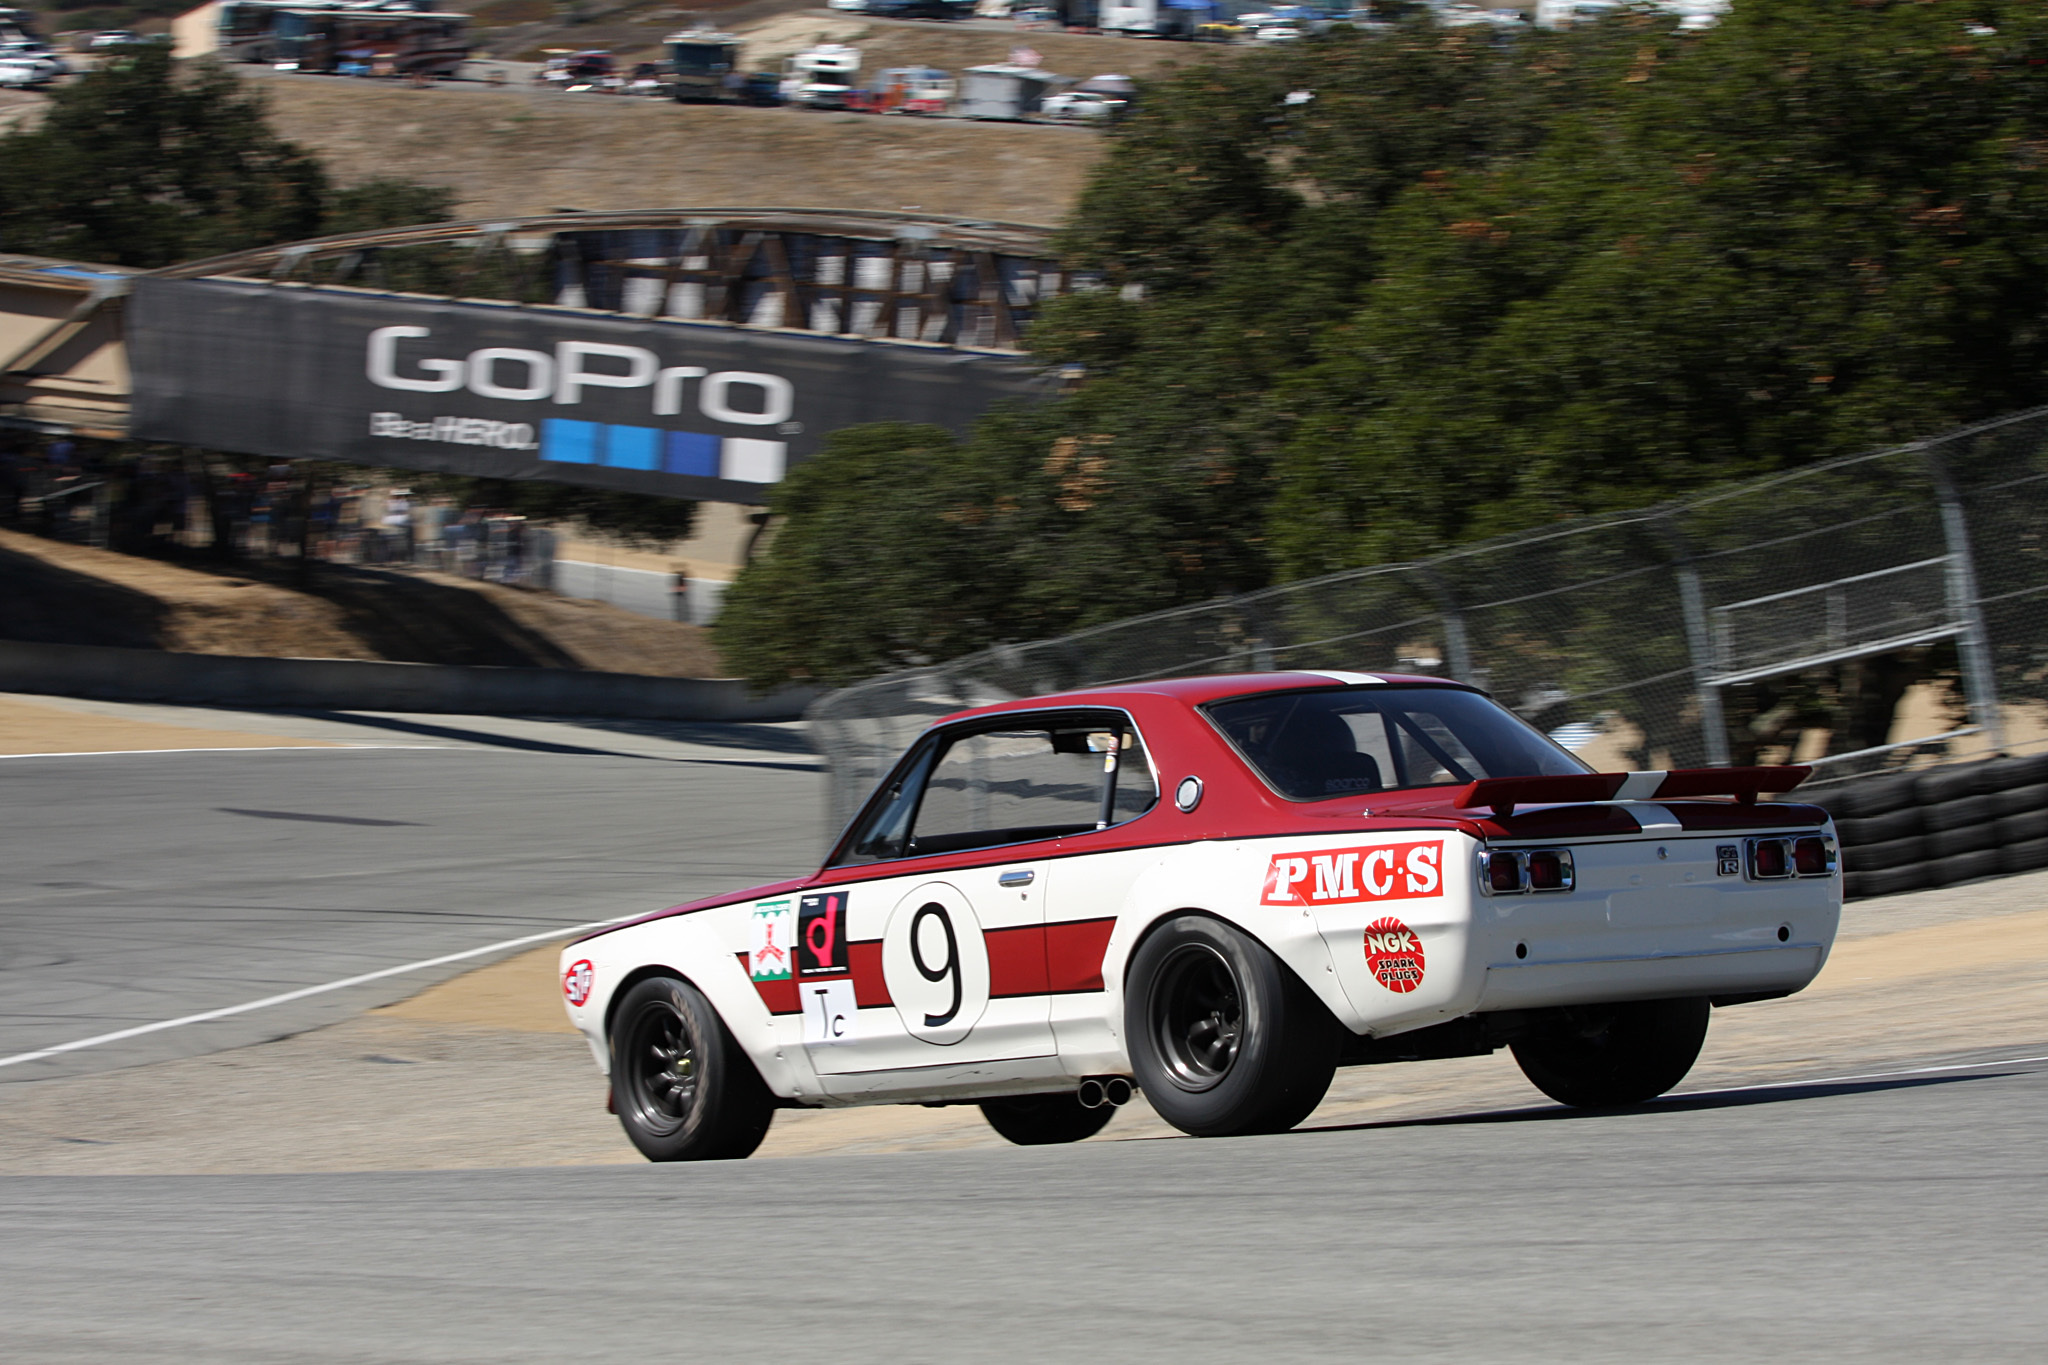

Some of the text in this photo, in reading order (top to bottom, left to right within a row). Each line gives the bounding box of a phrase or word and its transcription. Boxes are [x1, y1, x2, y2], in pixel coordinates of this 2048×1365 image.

[367, 326, 793, 425] GoPro
[1724, 861, 1738, 873] R
[1366, 931, 1416, 955] NGK
[910, 902, 962, 1027] 9
[1378, 958, 1416, 970] SPARK
[1380, 970, 1419, 982] PLUGS
